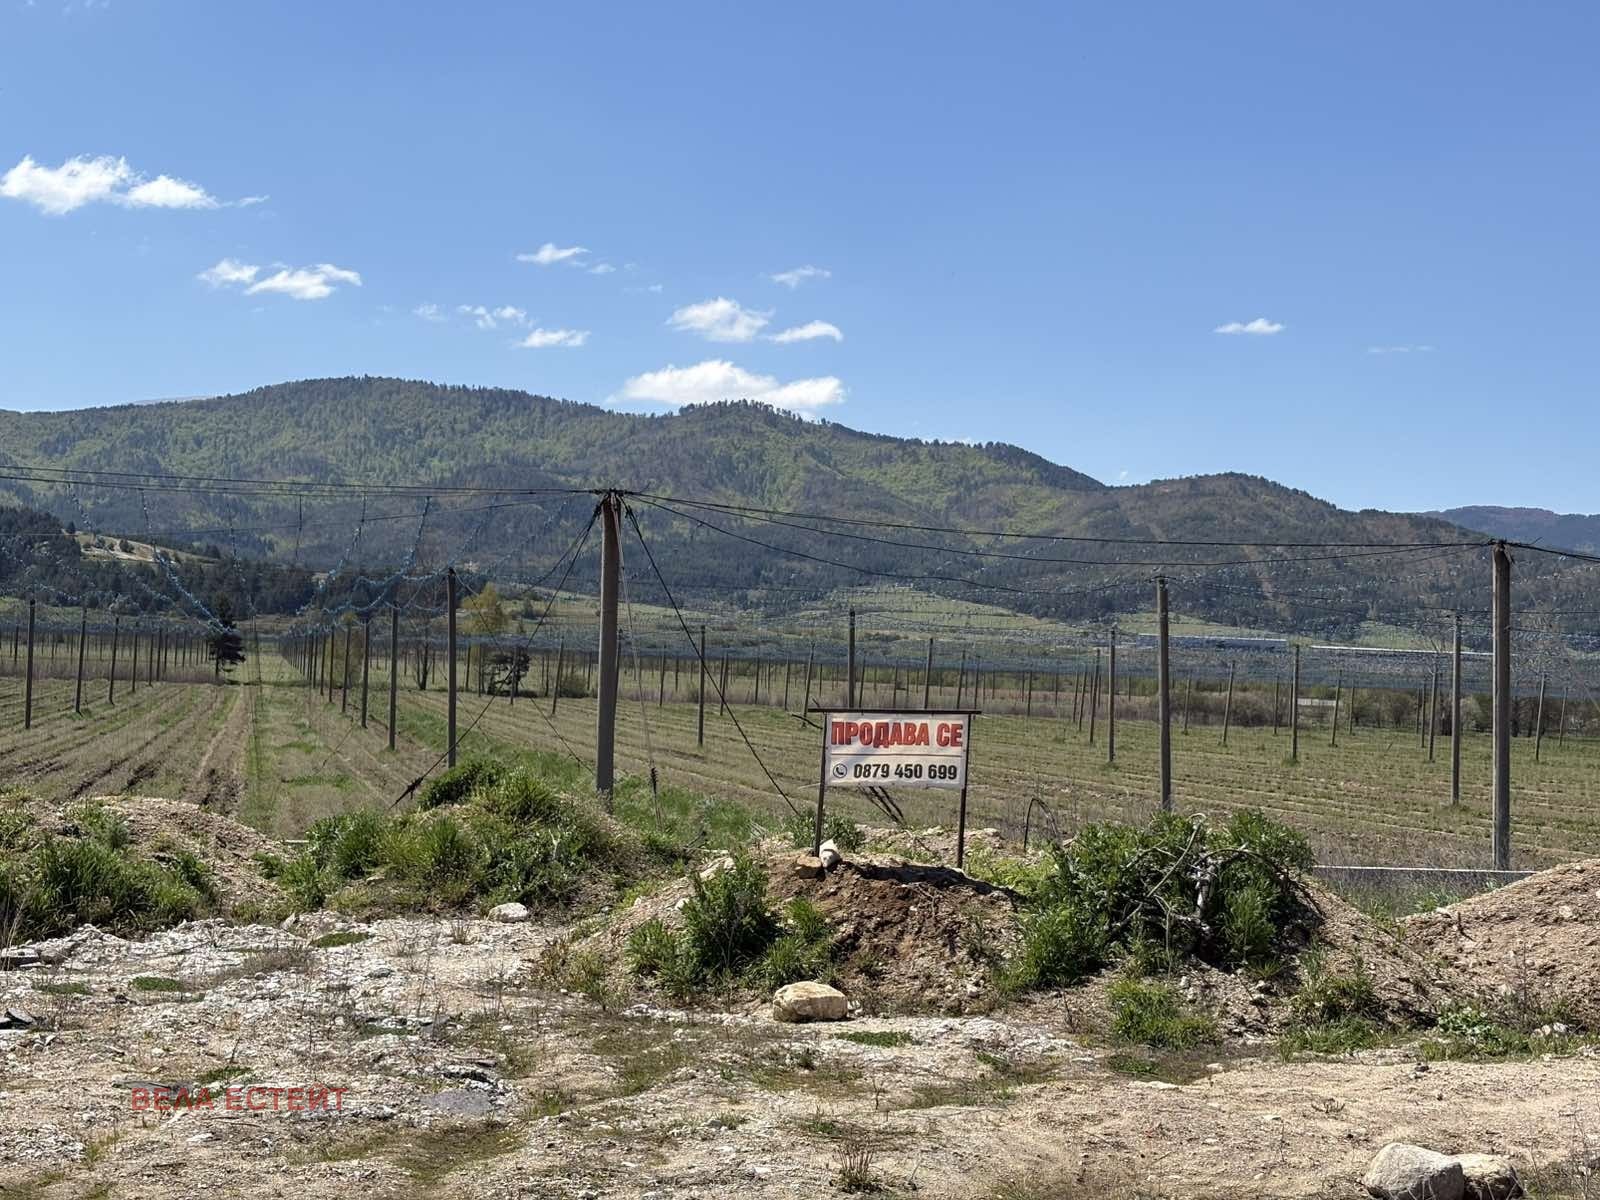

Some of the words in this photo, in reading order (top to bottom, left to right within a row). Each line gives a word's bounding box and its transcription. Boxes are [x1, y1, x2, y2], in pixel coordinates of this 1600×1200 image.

[831, 721, 930, 748] ПРОДАВА
[936, 723, 963, 747] СЕ
[853, 763, 890, 779] 0879
[894, 764, 923, 779] 450
[928, 765, 957, 780] 699
